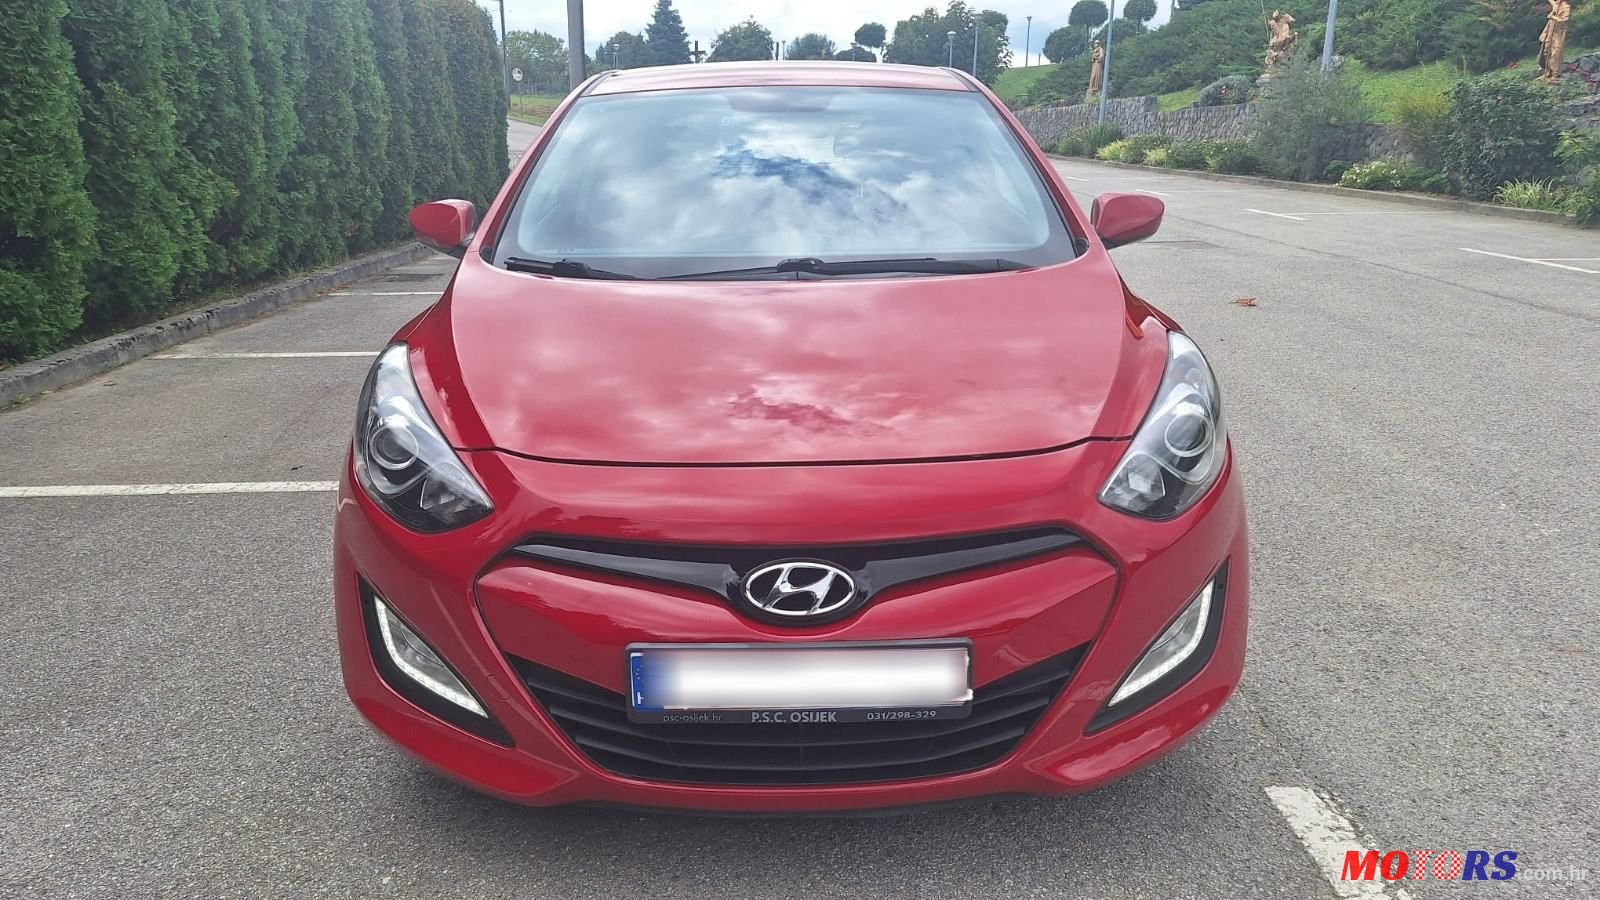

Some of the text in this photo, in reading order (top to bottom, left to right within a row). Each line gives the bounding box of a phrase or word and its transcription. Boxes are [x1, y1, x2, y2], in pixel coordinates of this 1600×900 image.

[751, 711, 837, 723] P.S.C. OSIJEK
[867, 710, 936, 720] 031/298-329
